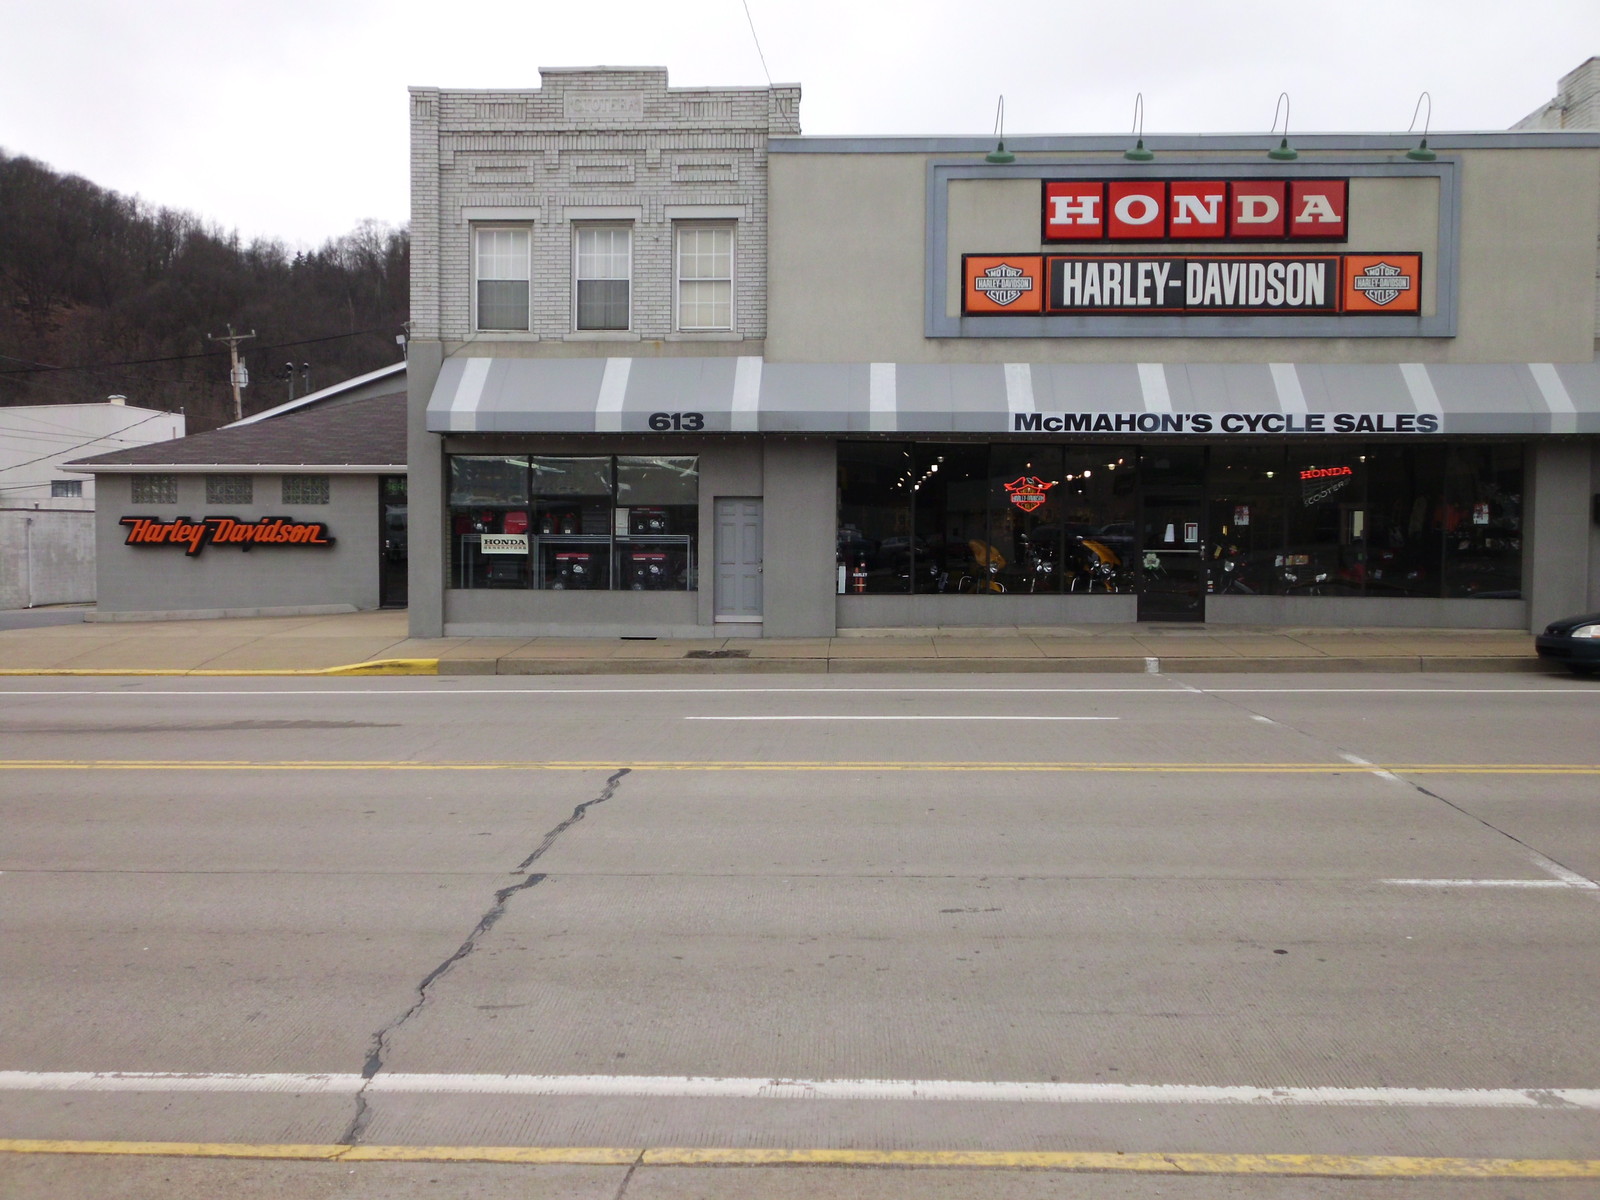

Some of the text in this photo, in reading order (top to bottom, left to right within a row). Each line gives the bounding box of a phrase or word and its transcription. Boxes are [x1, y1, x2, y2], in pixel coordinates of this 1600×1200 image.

[1050, 194, 1341, 225] HONDA
[990, 266, 1017, 277] MOTOR
[1369, 265, 1395, 276] MOTOR
[978, 279, 1029, 288] HARLEY-DAVIDSON
[1063, 262, 1326, 306] HARLEY-DAVIDSON
[1357, 278, 1407, 287] HARLEY-DAVIDSON
[990, 290, 1017, 302] CYCLES
[1369, 290, 1395, 302] CYCLES
[649, 412, 705, 431] 613
[1014, 413, 1438, 432] McMAHON'S CYCLE SALES
[1300, 466, 1353, 480] HONDA
